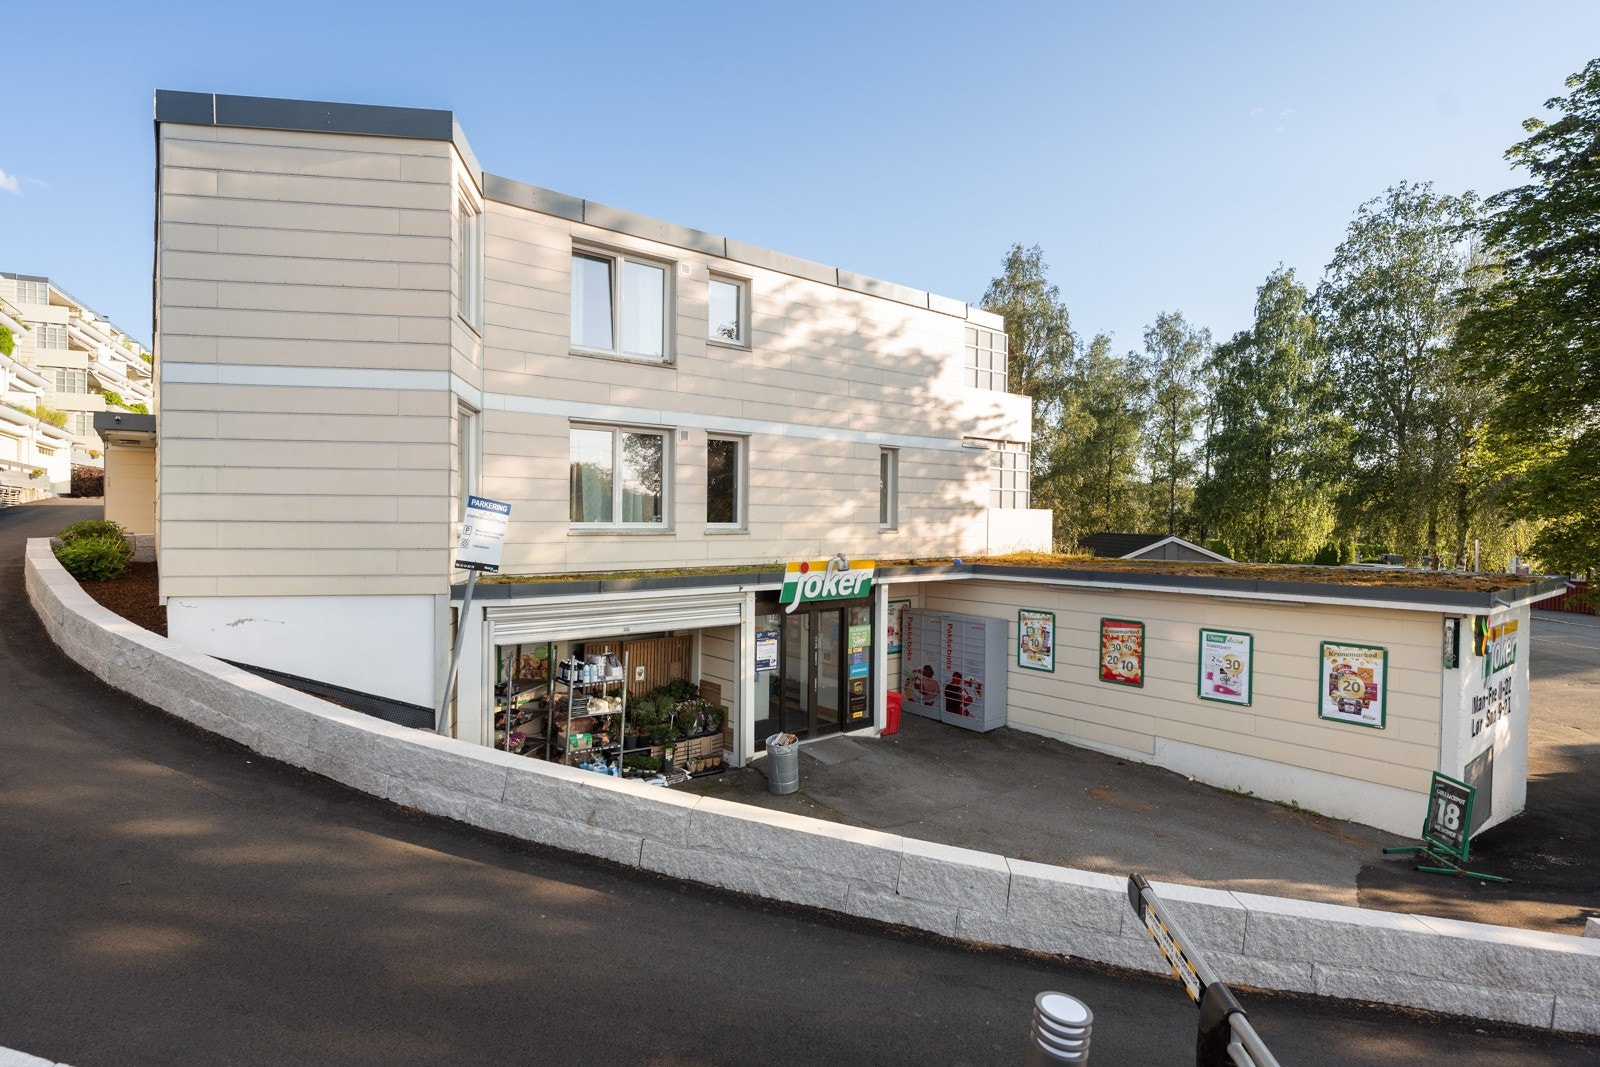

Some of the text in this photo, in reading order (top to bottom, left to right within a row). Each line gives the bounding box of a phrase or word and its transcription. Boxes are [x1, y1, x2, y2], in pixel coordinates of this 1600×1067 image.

[471, 499, 508, 512] PARKERING
[785, 559, 869, 614] joker
[1030, 639, 1040, 648] 10
[1111, 643, 1133, 652] 30 40
[1107, 655, 1119, 665] 20
[1121, 660, 1134, 672] 10
[1225, 658, 1241, 671] 30
[1342, 680, 1361, 693] 20
[1437, 798, 1460, 831] 18
